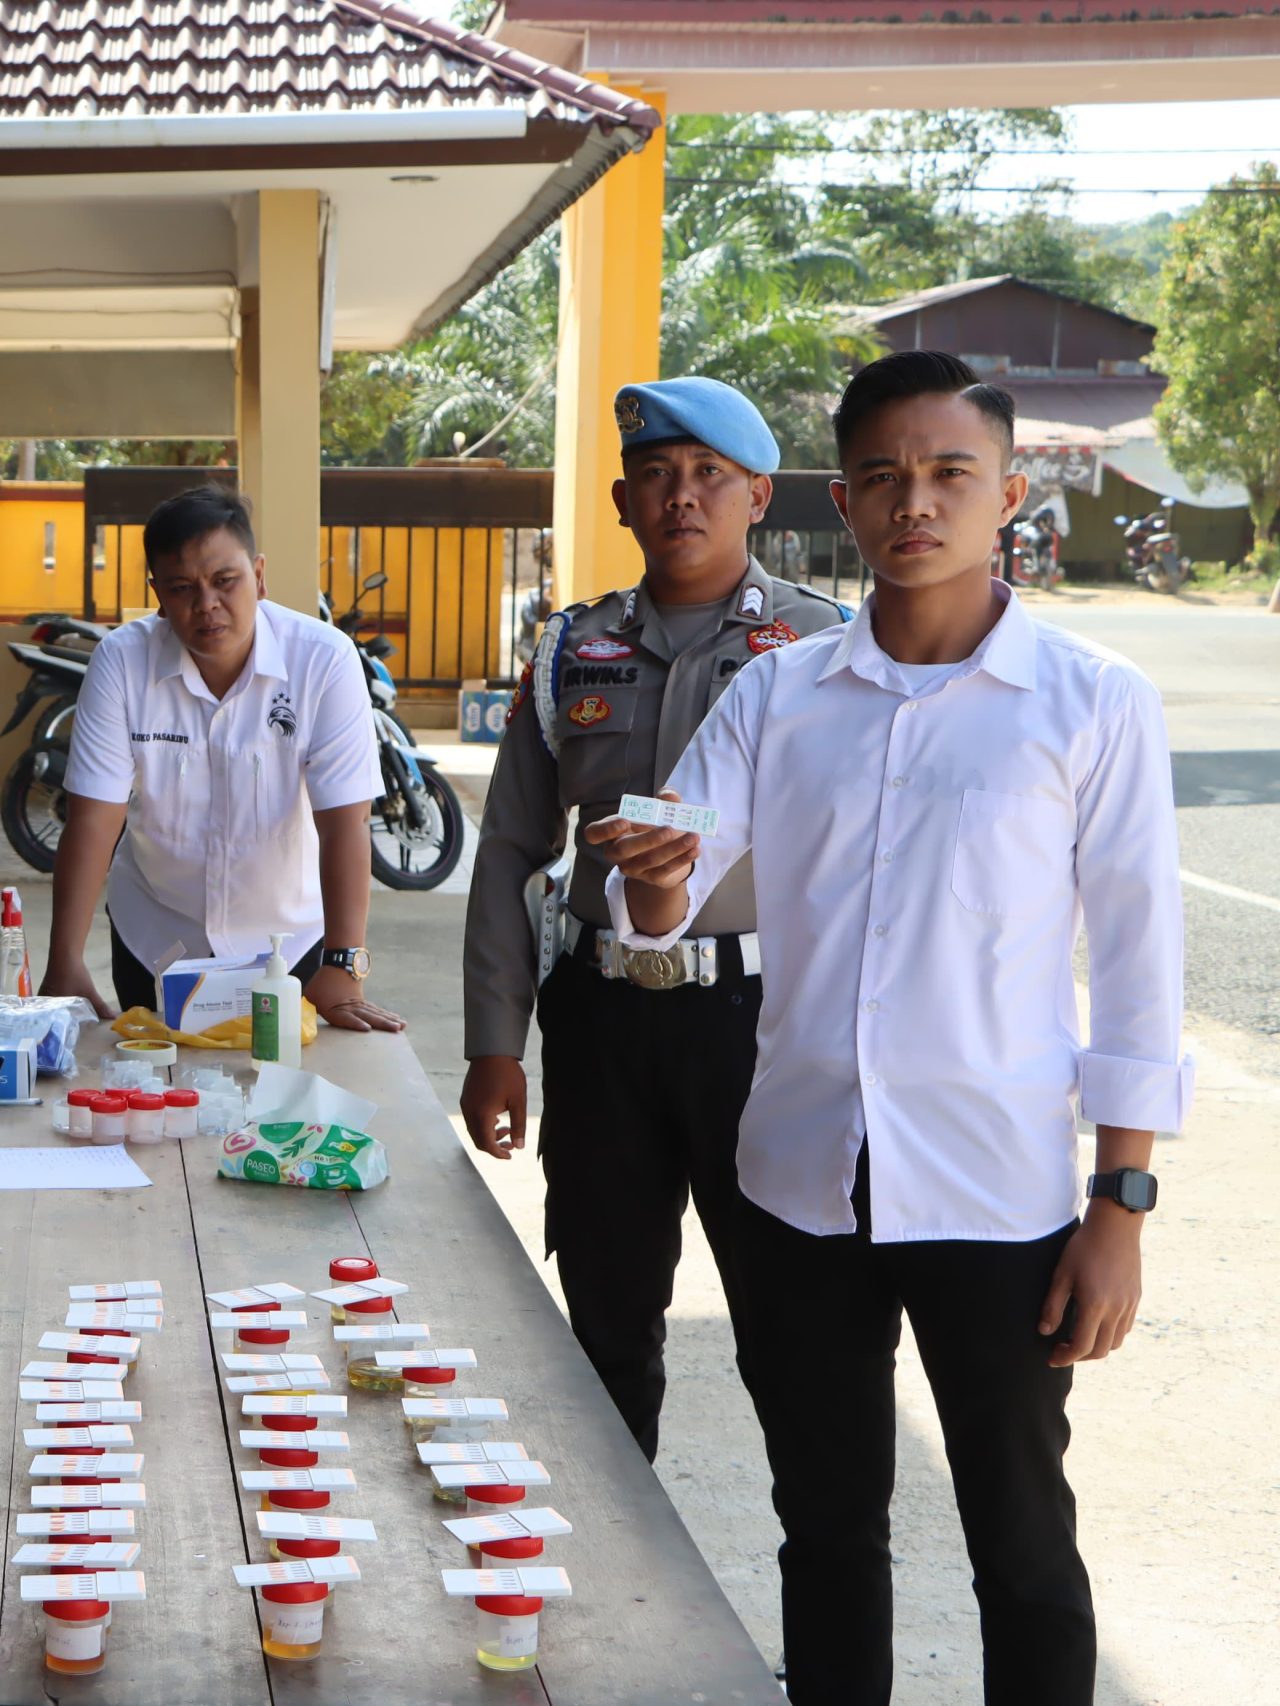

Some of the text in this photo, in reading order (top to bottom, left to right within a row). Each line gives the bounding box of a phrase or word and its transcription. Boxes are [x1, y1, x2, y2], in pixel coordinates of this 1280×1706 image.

[131, 733, 189, 744] KOKO PASARIBU
[247, 1158, 276, 1174] PASEO
